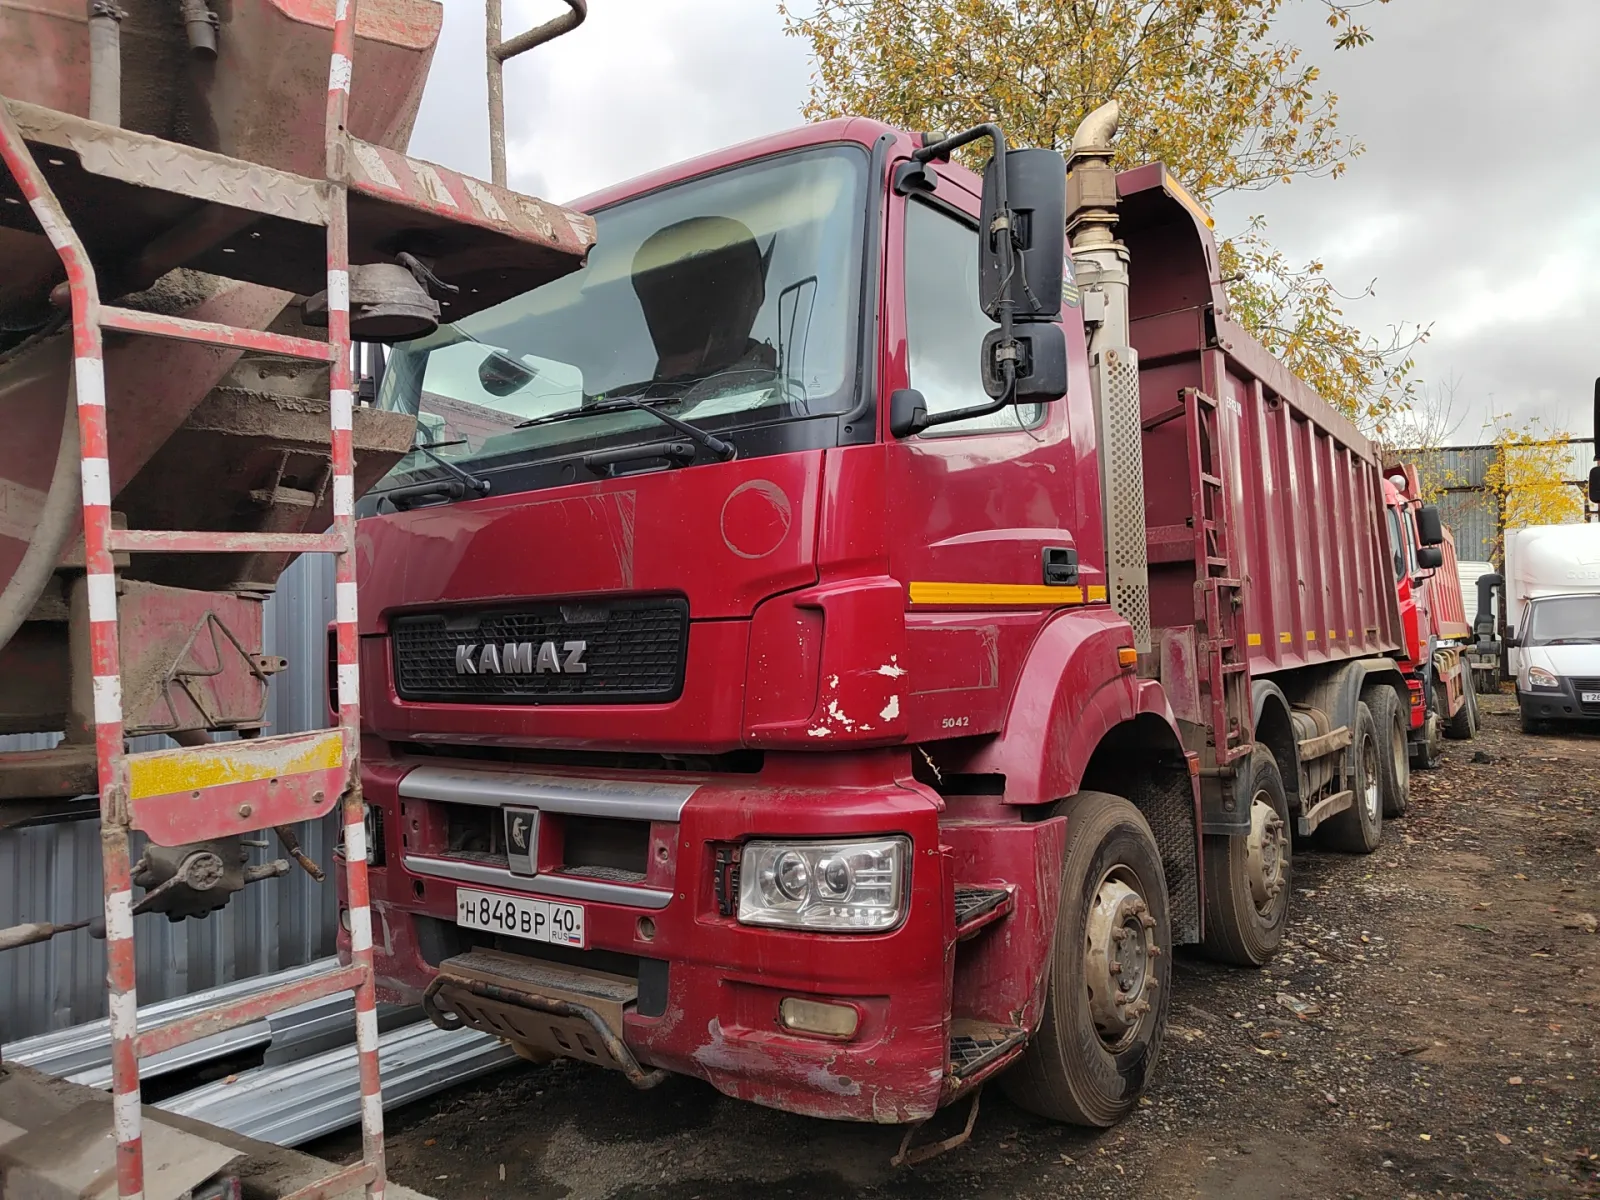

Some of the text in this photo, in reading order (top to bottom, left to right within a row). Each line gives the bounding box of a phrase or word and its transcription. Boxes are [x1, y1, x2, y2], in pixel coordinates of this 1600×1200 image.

[455, 640, 587, 674] KAMAZ
[942, 716, 969, 729] 5042
[552, 907, 575, 932] 40
[551, 930, 568, 941] RUS
